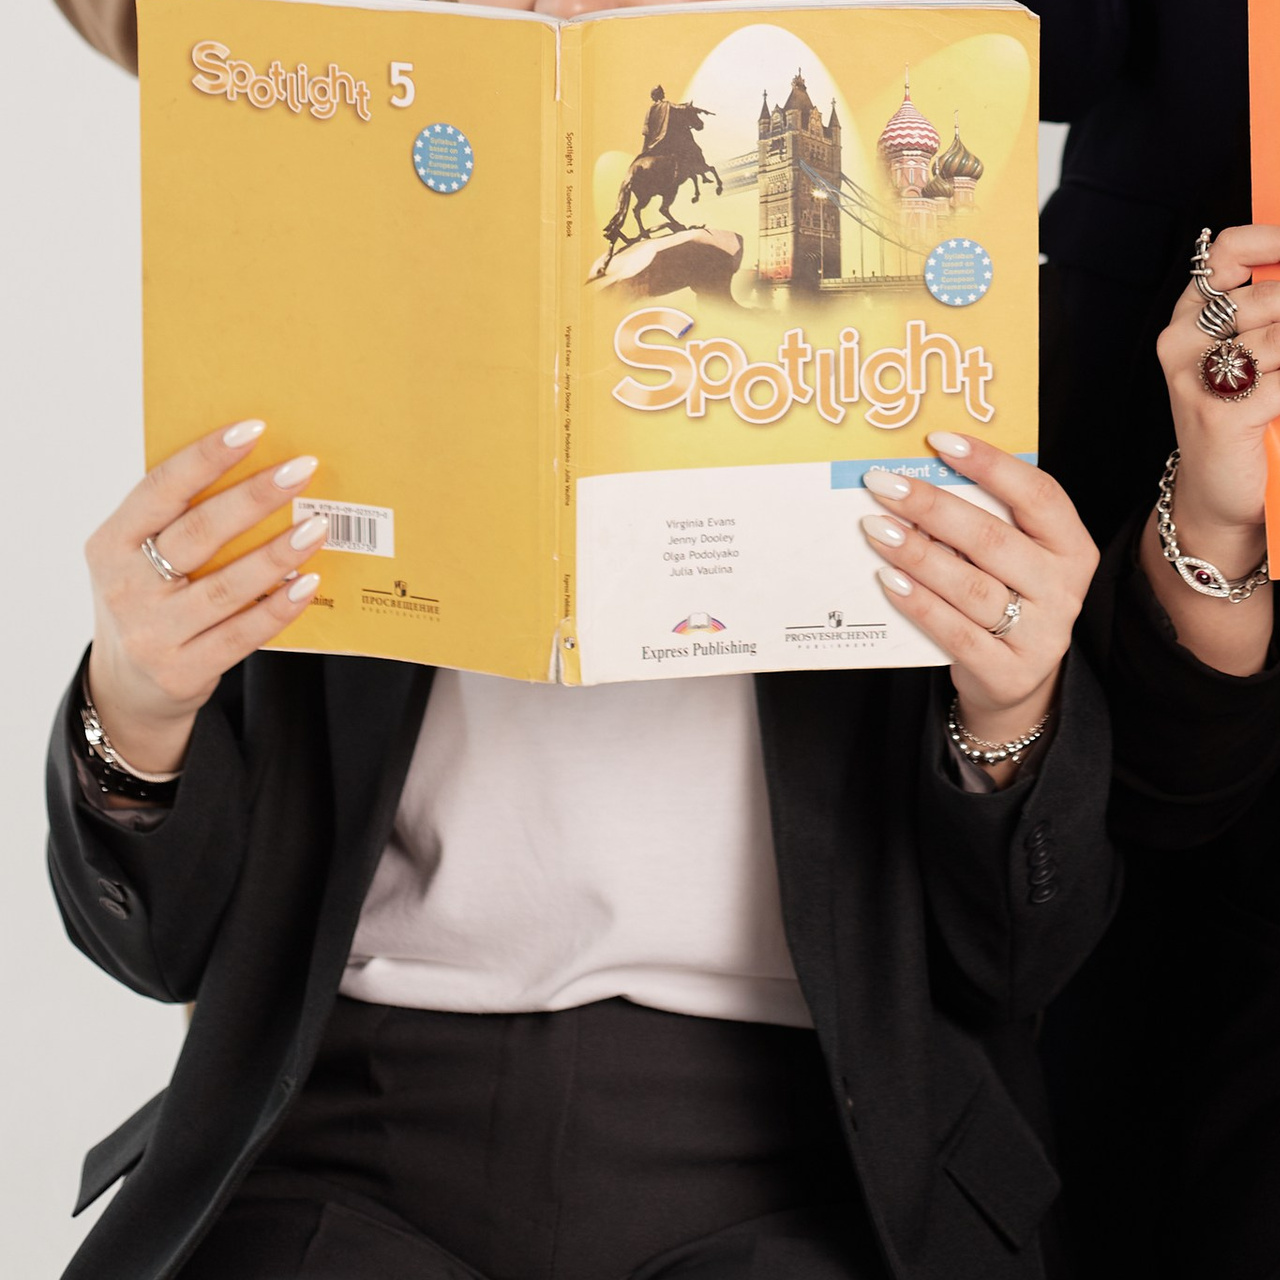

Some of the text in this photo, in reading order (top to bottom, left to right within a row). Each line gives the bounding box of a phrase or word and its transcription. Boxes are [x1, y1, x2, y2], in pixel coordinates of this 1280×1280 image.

[191, 40, 415, 121] Spotlight 5
[565, 131, 574, 166] Spotlight
[612, 306, 994, 429] Spotlight
[666, 517, 736, 531] Virginia Evans
[668, 533, 734, 546] Jenny Dooley
[663, 548, 739, 563] Olga Podolyako
[669, 565, 733, 577] Julia Vaulina
[361, 594, 440, 615] ПРОСВЕЩЕНИЕ
[785, 630, 888, 643] PROSVESHCHENIYE
[641, 640, 757, 662] Express Publishing
